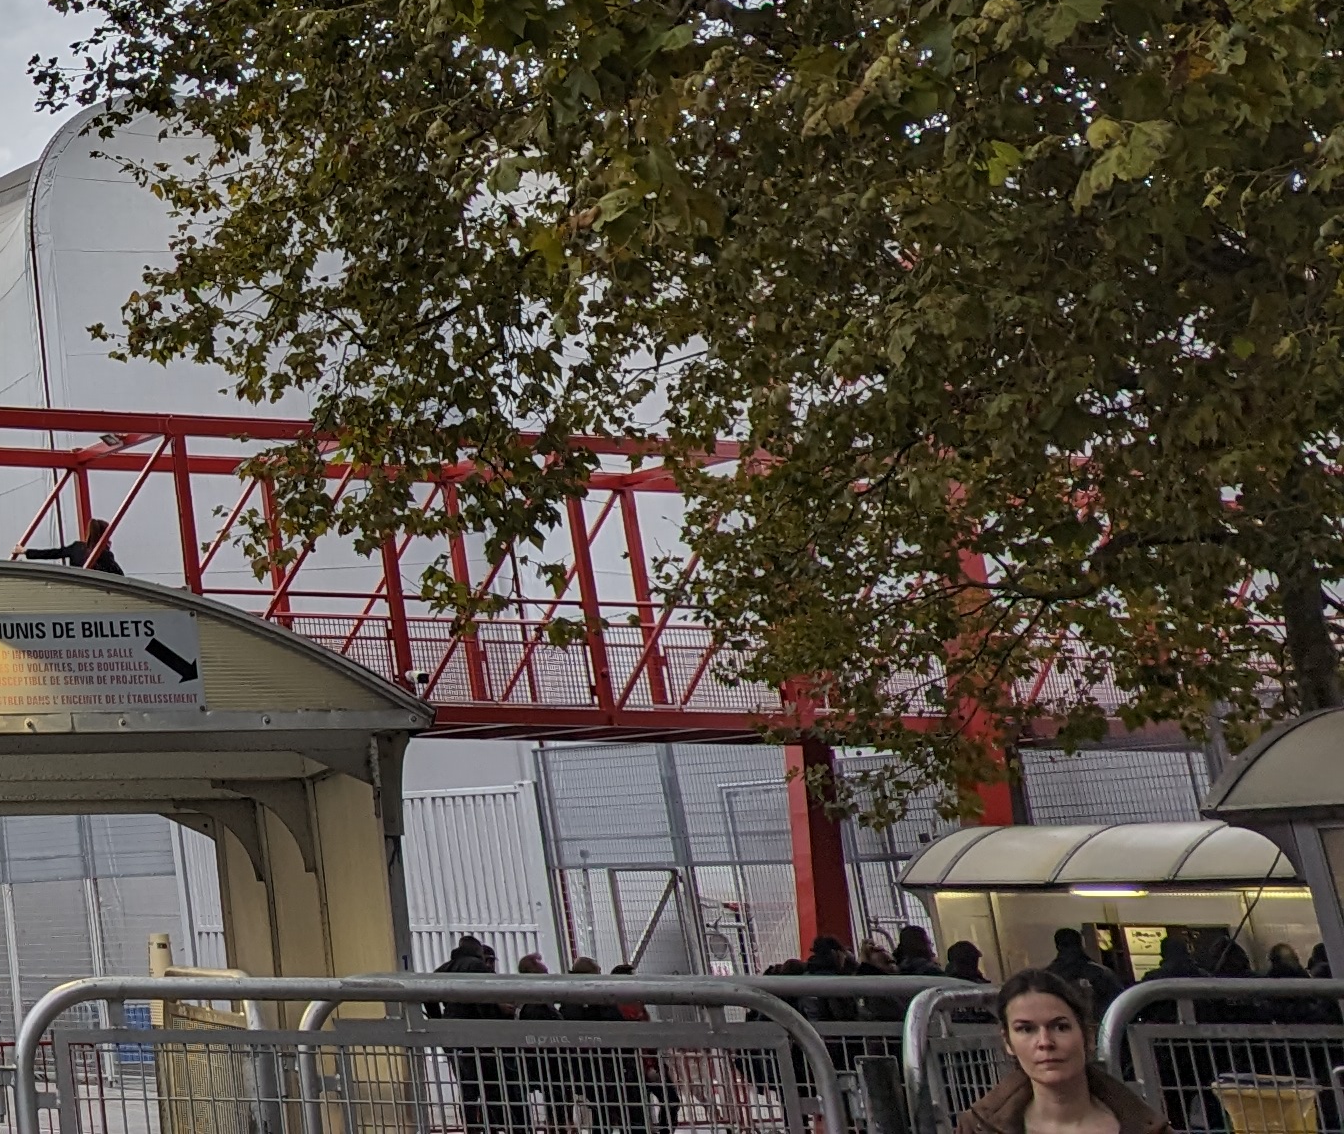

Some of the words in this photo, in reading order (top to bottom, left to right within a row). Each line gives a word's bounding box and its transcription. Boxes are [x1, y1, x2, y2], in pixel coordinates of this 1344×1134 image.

[52, 621, 75, 639] DE
[81, 620, 155, 639] BILLETS
[66, 648, 90, 659] DANS
[92, 648, 104, 658] LA
[107, 648, 133, 658] SALLE
[13, 663, 24, 673] OU
[27, 662, 76, 673] VOLATILES,
[78, 661, 94, 672] DES
[97, 660, 152, 672] BOUTEILLES,
[50, 675, 61, 686] DE
[63, 674, 94, 685] SERVIR
[97, 674, 108, 684] DE
[27, 695, 51, 705] DANS
[105, 694, 116, 704] DE
